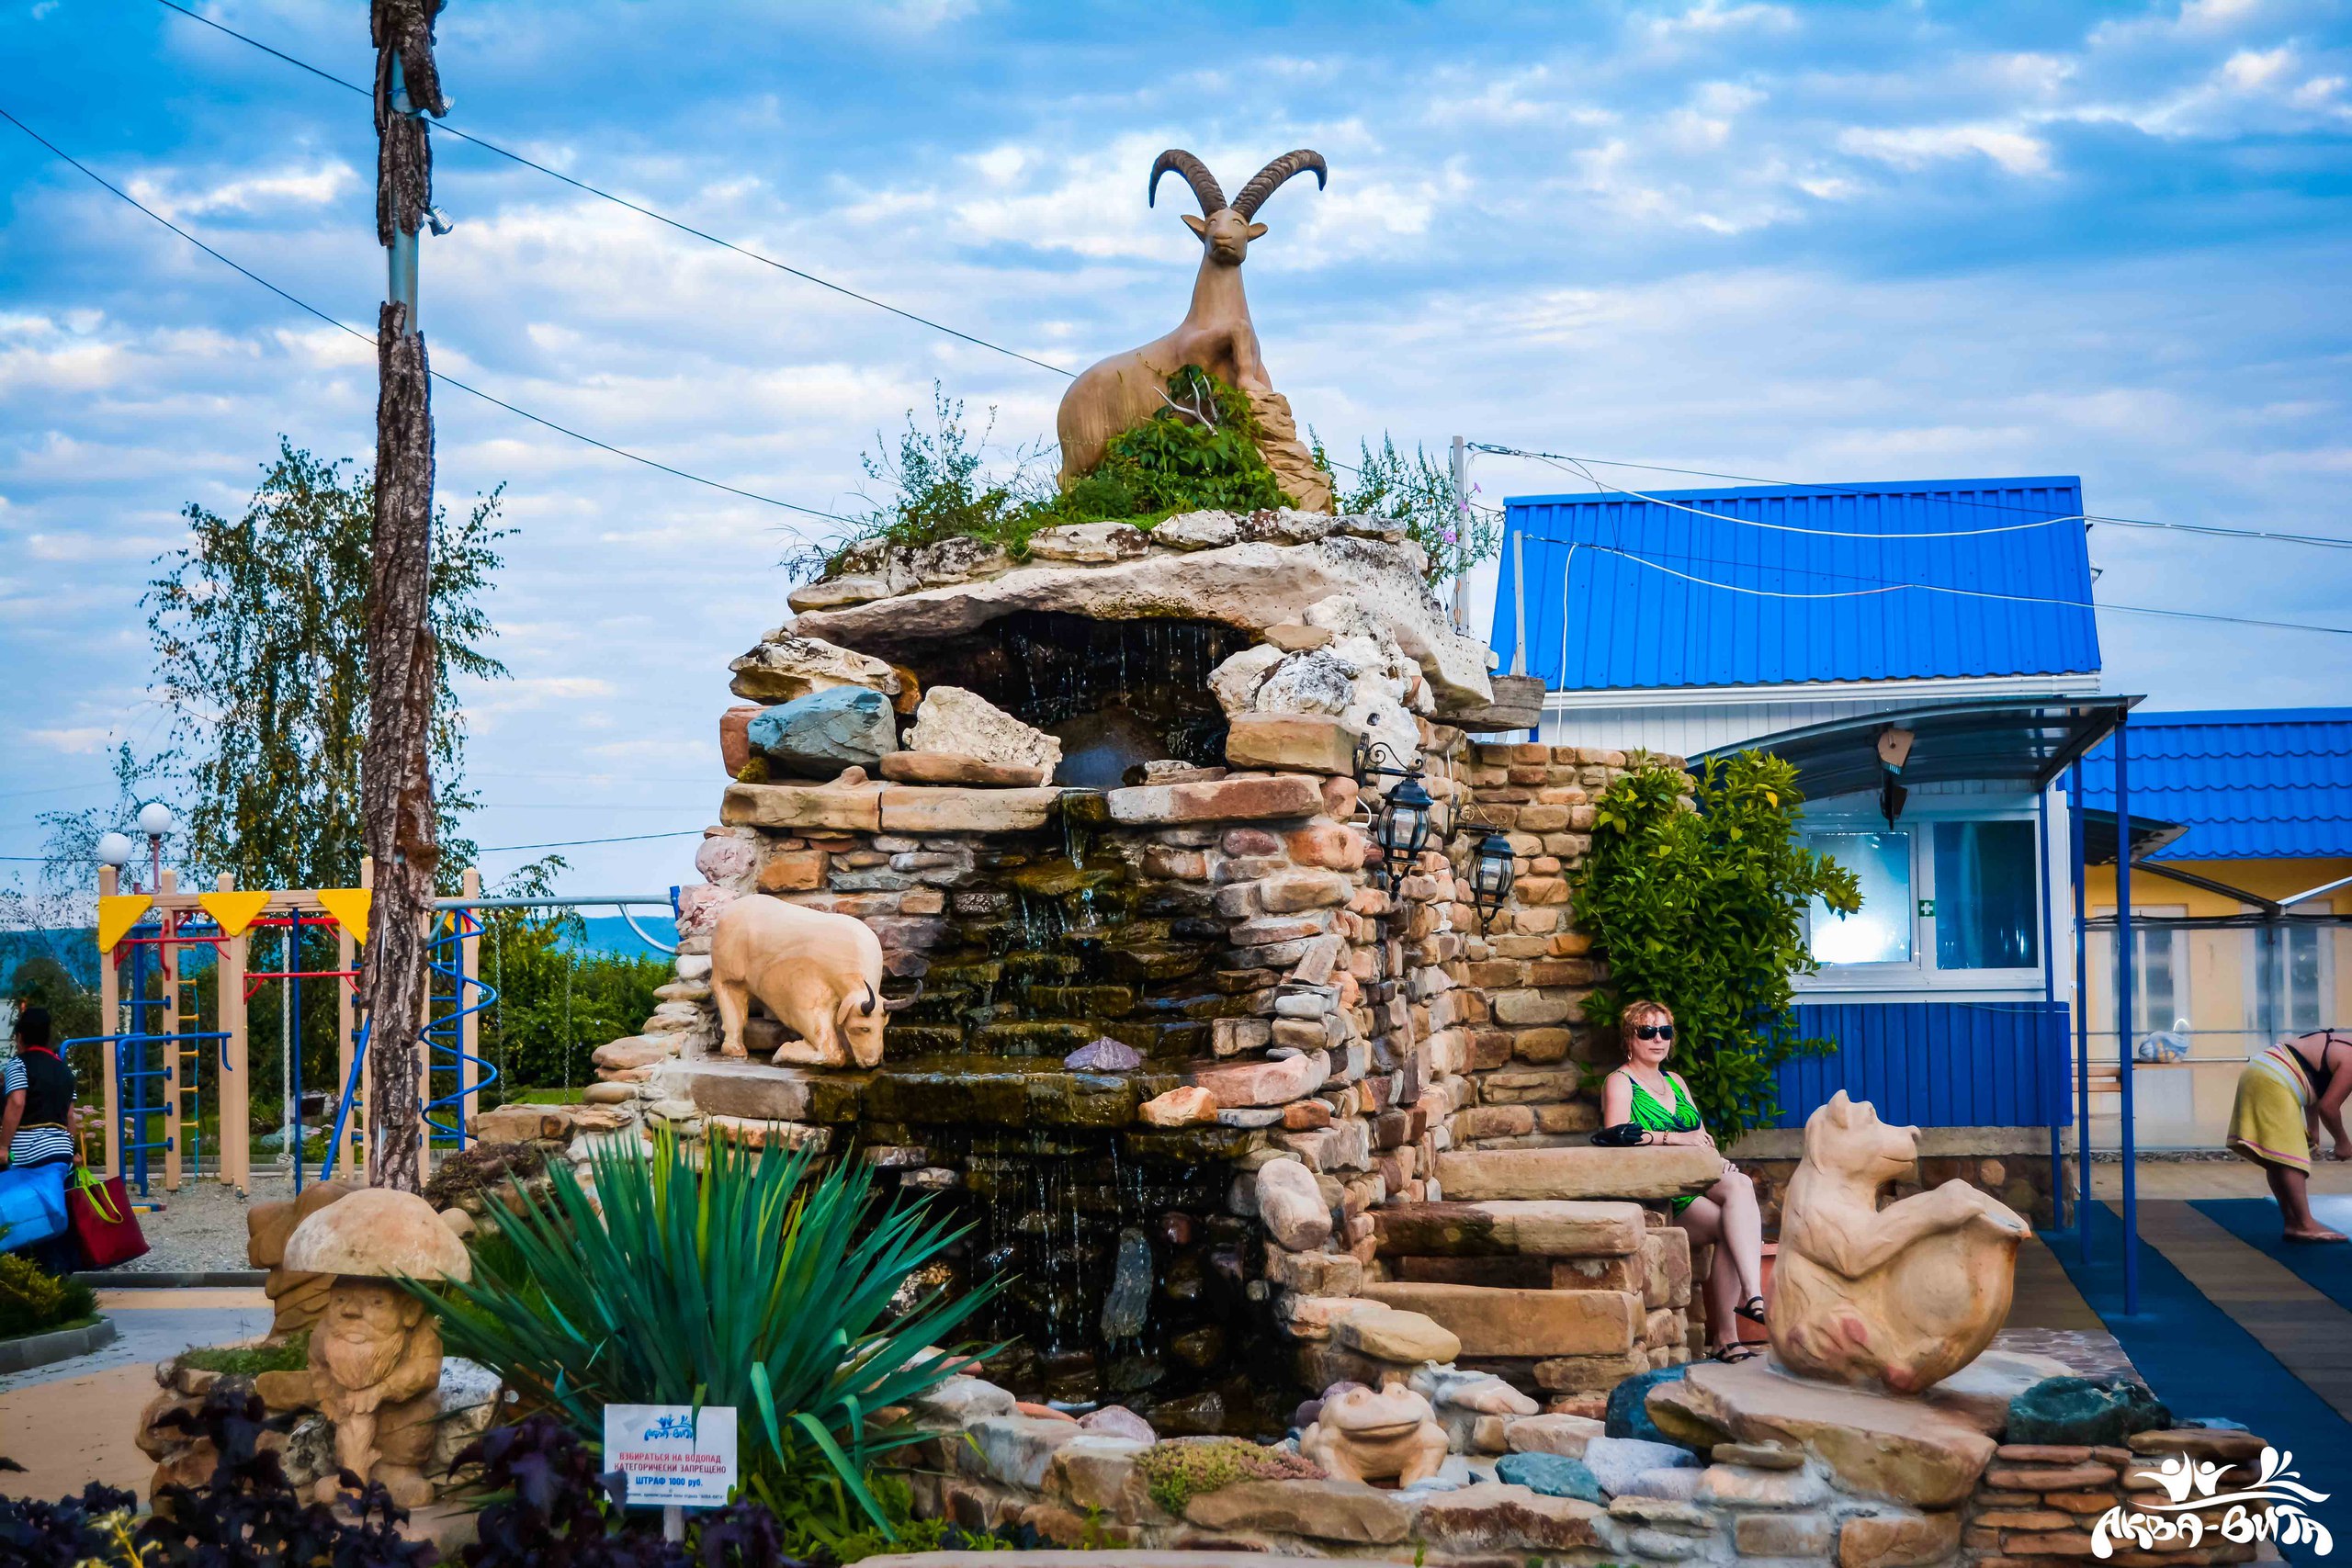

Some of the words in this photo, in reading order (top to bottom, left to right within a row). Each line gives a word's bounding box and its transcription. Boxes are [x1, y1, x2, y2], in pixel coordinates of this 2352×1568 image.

[619, 1452, 669, 1461] ВЗБИРАТЬСЯ
[684, 1454, 721, 1463] ВОДОПАД
[614, 1462, 677, 1472] КАТЕГОРИЧЕСКИ
[680, 1464, 727, 1473] ЗАПРЕЩЕНО
[636, 1476, 666, 1485] ШТРАФ
[687, 1478, 703, 1487] руб.
